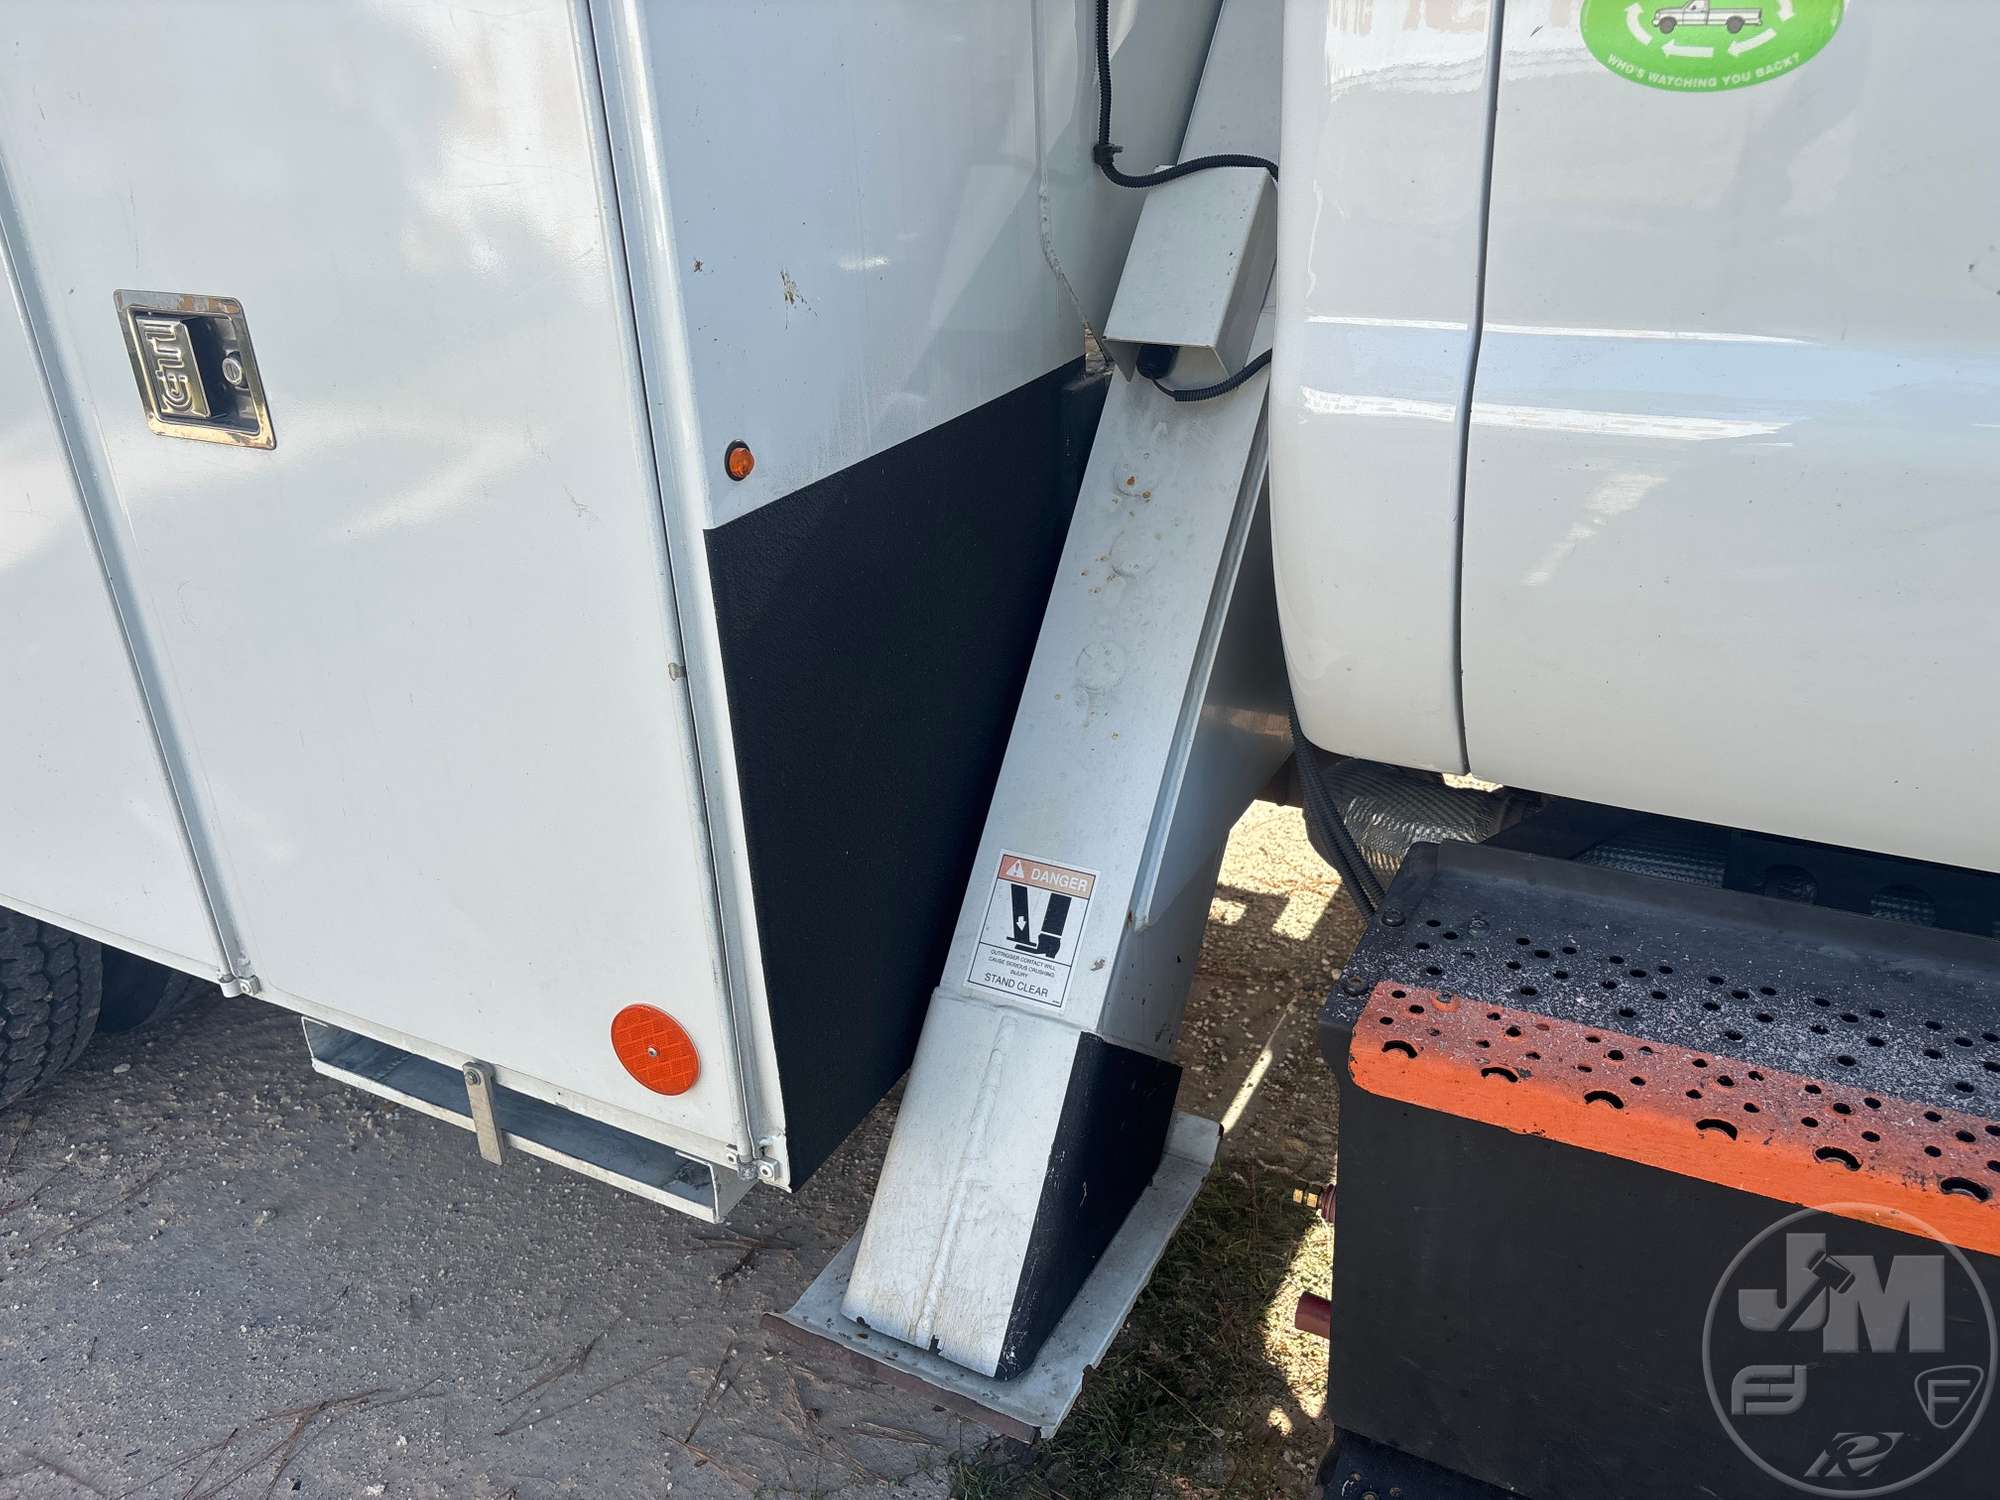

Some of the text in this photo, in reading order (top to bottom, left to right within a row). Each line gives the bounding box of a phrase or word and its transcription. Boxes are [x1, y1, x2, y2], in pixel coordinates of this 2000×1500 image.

[1607, 52, 1800, 88] WHO'S WATCHING YOU BACK?
[1031, 868, 1089, 892] DANGER
[988, 956, 1055, 978] CAUSE SERIOUS CRUSHING
[1010, 969, 1028, 978] INJURY
[1020, 957, 1043, 967] CONTACT
[1044, 963, 1056, 971] WILL
[984, 972, 1049, 997] STAND CLEAR
